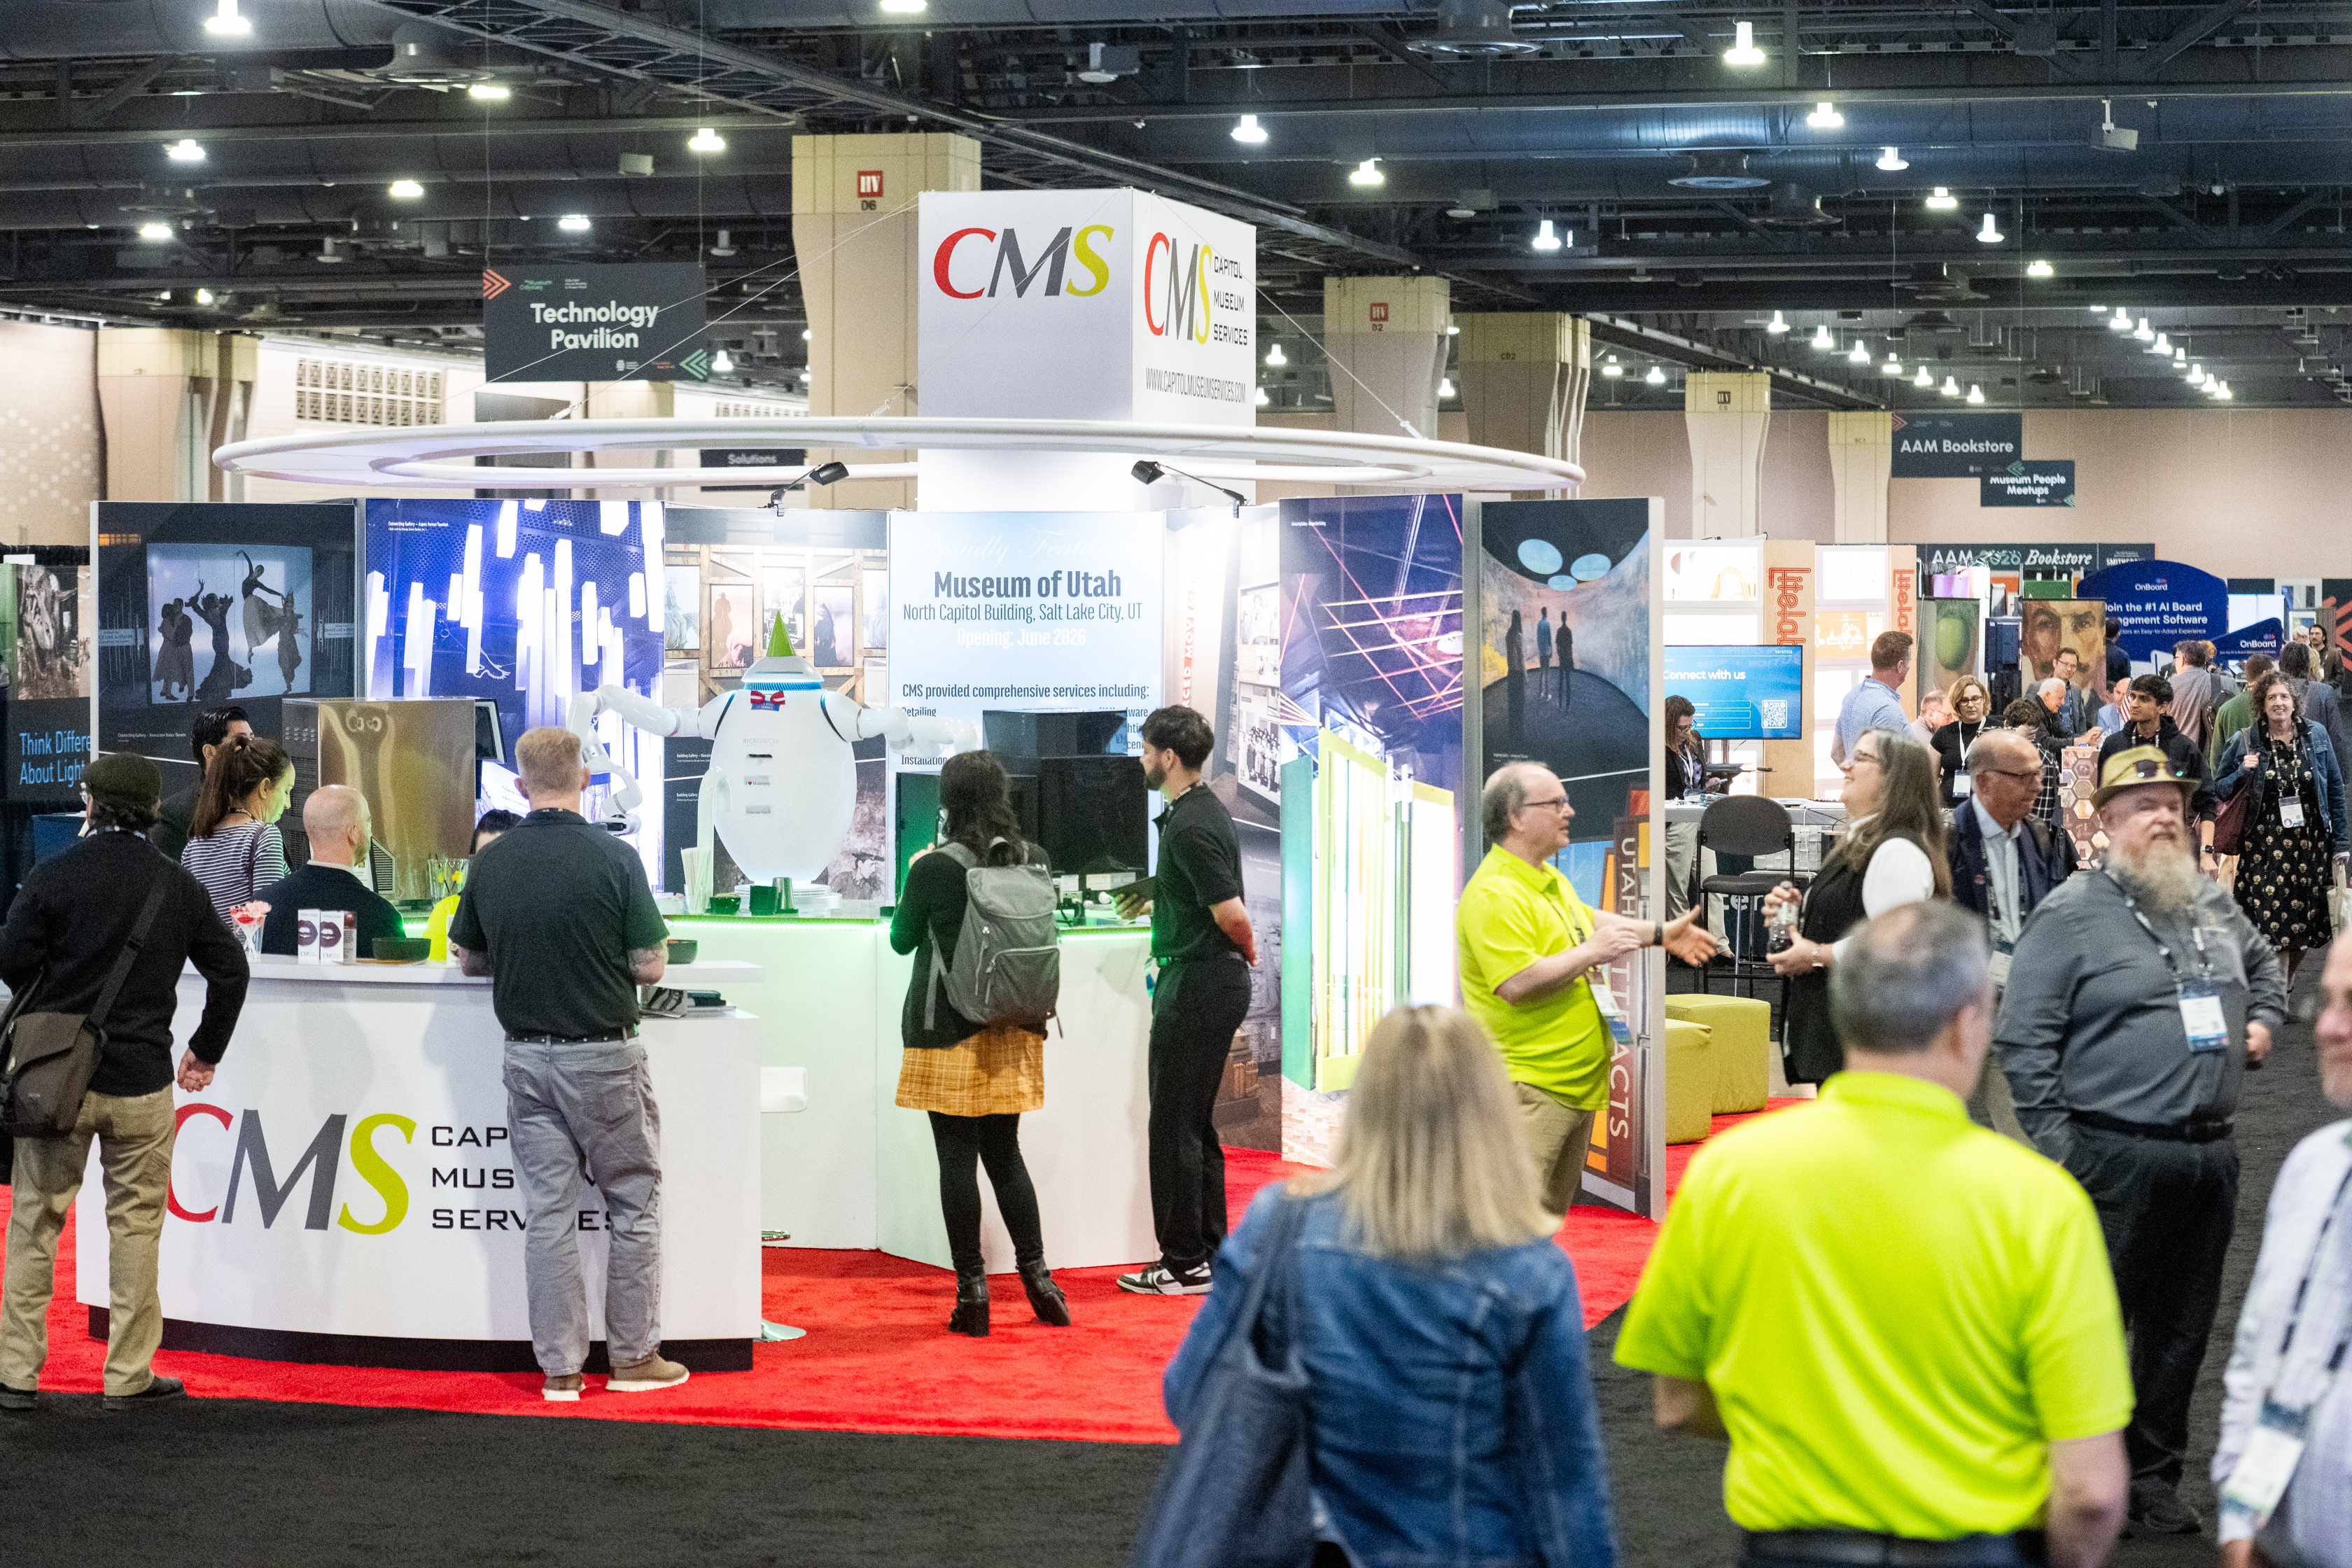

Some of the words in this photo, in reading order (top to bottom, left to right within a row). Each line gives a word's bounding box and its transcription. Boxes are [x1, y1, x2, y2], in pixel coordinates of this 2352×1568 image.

[933, 224, 1115, 300] CMS
[1213, 255, 1243, 280] CAPITOL
[1144, 231, 1212, 345] CMS
[1213, 290, 1245, 313] MUSEUM
[530, 300, 659, 328] Technology
[551, 327, 639, 349] Pavilion
[1372, 323, 1383, 332] D2
[1145, 366, 1247, 404] WWW.CAPITOLMUSEUMSERVICES.COM
[1900, 440, 1938, 453] AAM
[1942, 439, 2014, 453] Bookstore
[727, 454, 777, 465] Solutions
[1989, 476, 2031, 484] Museum
[2033, 474, 2066, 486] People
[2007, 485, 2050, 497] Meetups
[906, 529, 1011, 568] Proudly
[1017, 527, 1152, 567] Featuring
[1932, 549, 1973, 564] AAM
[2024, 548, 2093, 566] Bookstore
[934, 570, 1031, 598] Museum
[1037, 570, 1062, 598] of
[1067, 569, 1121, 598] Utah
[2135, 583, 2168, 592] OnBoard
[903, 603, 936, 620] North
[939, 603, 981, 624] Capitol
[984, 603, 1036, 624] Building,
[1039, 603, 1063, 620] Salt
[1066, 603, 1095, 620] Lake
[1098, 603, 1124, 624] City,
[1127, 603, 1143, 620] UT
[2125, 602, 2142, 612] the
[2145, 602, 2157, 612] #1
[2159, 602, 2170, 612] AI
[2172, 601, 2202, 612] Board
[2163, 615, 2208, 625] Software
[957, 629, 1014, 650] Opening:
[1017, 629, 1050, 646] June
[1053, 628, 1086, 645] 2026
[2240, 640, 2276, 648] OnBoard
[1663, 670, 1707, 680] Connect
[1707, 669, 1731, 680] with
[1733, 671, 1746, 680] us
[902, 684, 923, 698] CMS
[925, 684, 970, 699] provided
[972, 684, 1051, 700] comprehensive
[1052, 684, 1096, 697] services
[1098, 683, 1149, 699] including:
[1181, 665, 1192, 708] RCED
[19, 732, 52, 756] Think
[19, 761, 54, 785] About
[1620, 836, 1637, 916] UTAH
[167, 1103, 417, 1235] CMS
[432, 1208, 614, 1232] SERVES
